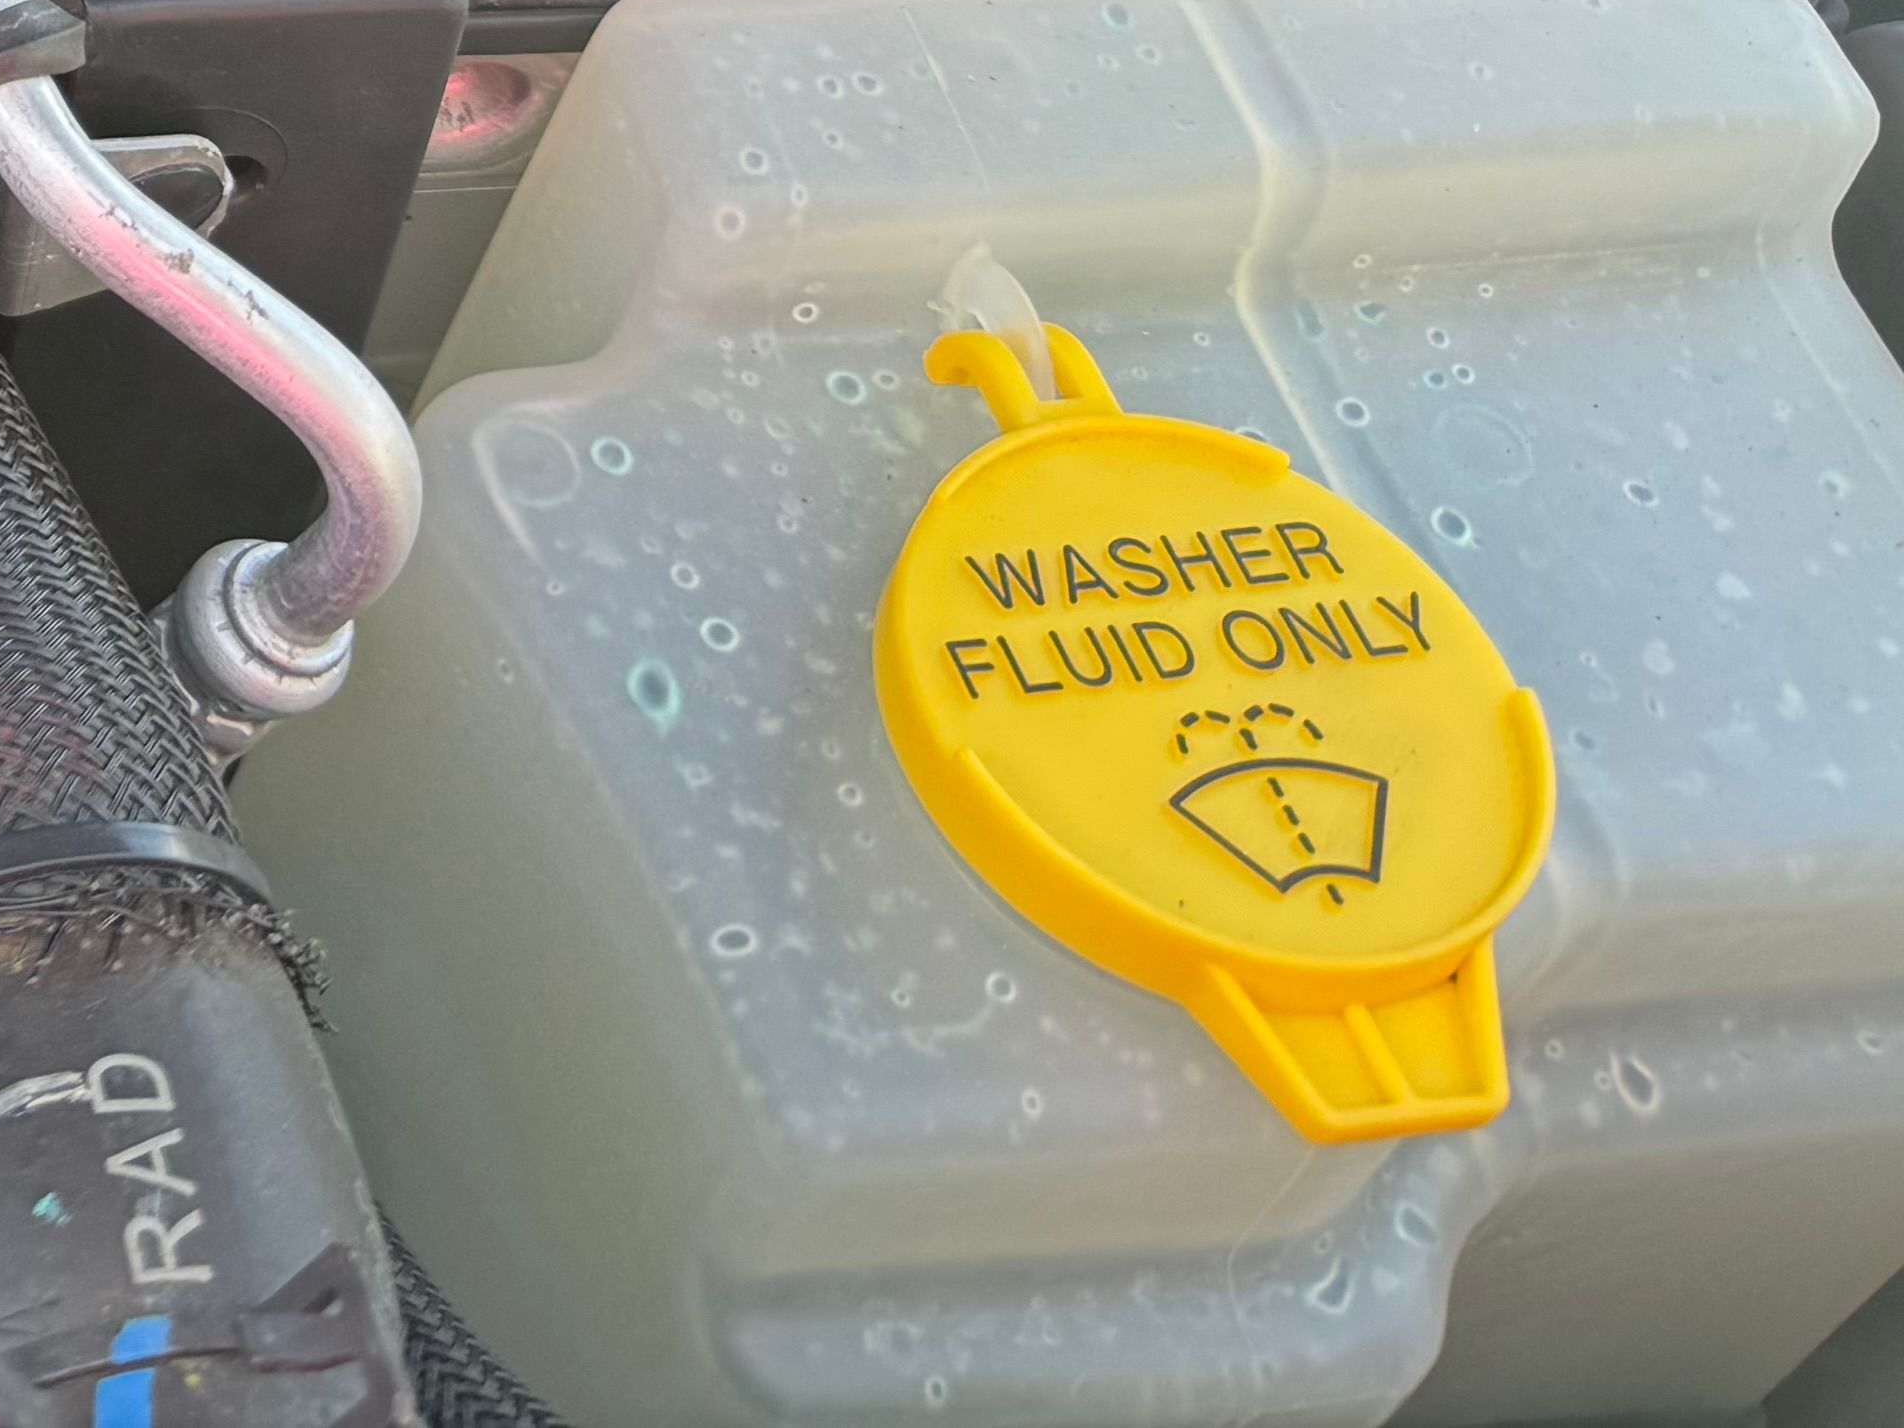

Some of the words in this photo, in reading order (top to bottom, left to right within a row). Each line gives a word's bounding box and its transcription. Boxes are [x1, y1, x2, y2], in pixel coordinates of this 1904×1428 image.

[966, 520, 1344, 609] WASHER
[945, 620, 1196, 700] FLUID
[1221, 591, 1432, 671] ONLY
[88, 1052, 214, 1283] RAD
